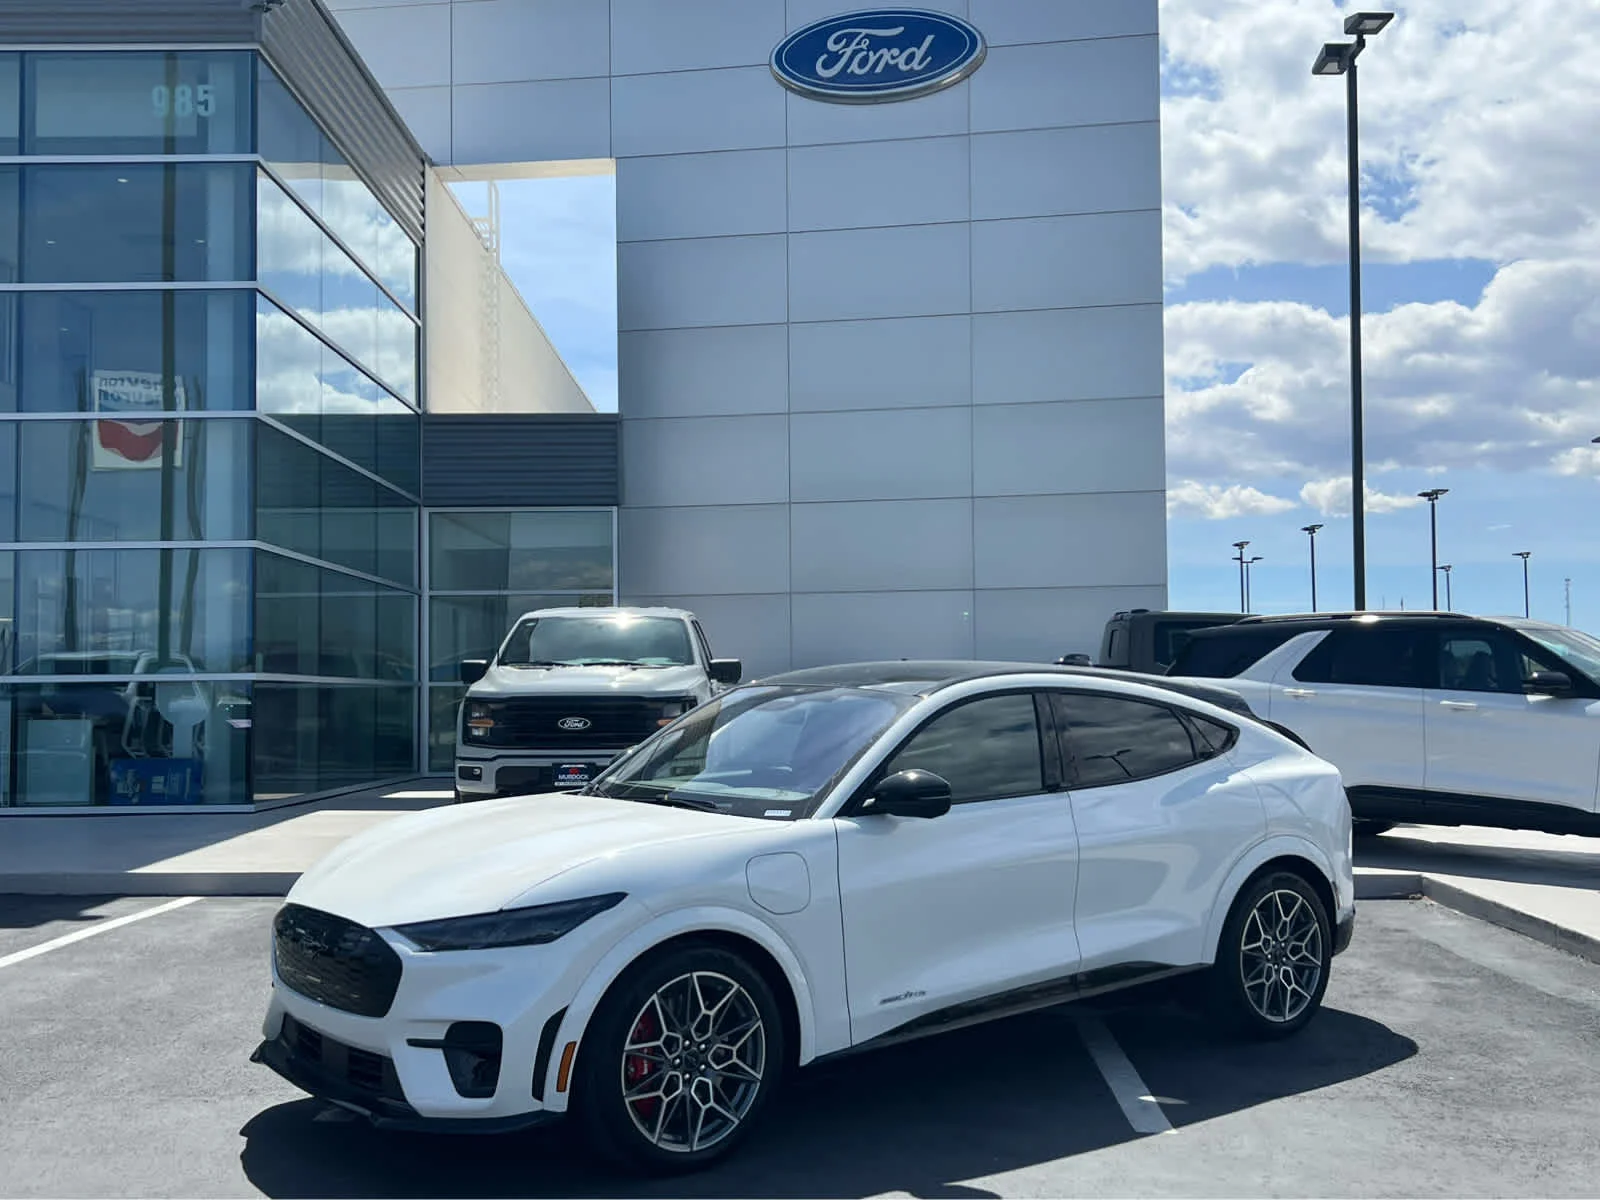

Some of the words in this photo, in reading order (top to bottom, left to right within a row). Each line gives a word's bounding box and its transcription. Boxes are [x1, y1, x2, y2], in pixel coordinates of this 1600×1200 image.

[815, 26, 935, 78] Ford
[152, 84, 216, 117] 985
[564, 719, 585, 728] Ford
